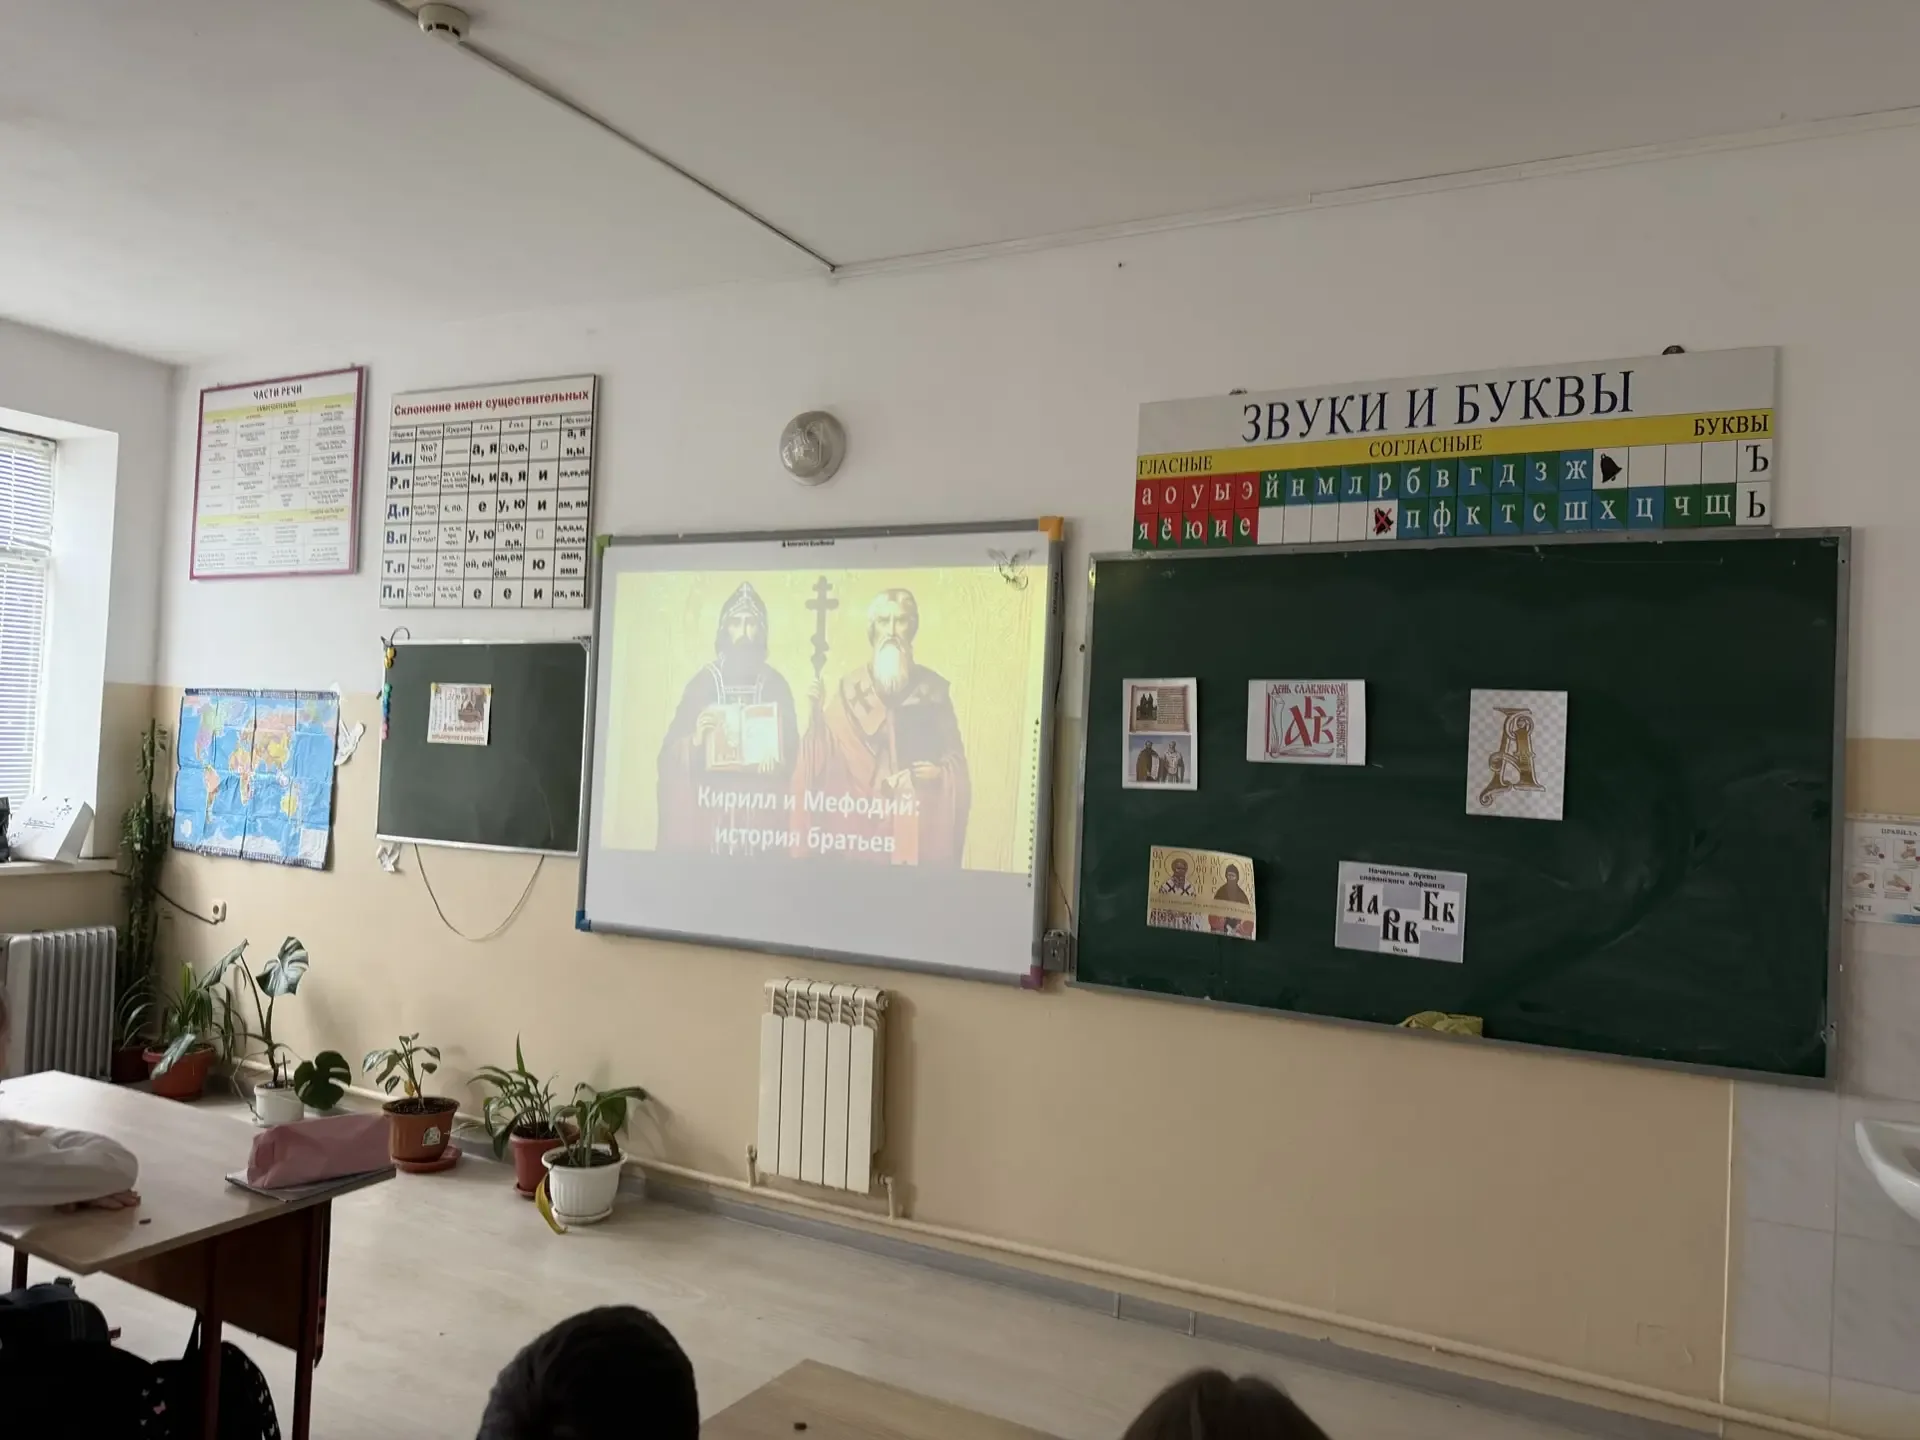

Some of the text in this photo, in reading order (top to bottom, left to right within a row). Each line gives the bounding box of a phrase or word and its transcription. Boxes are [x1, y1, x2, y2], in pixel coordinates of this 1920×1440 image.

[253, 384, 302, 400] ЧАСТИ РЕЧИ
[394, 390, 589, 416] Склонение имен существительных
[1242, 370, 1634, 443] ЗВУКИ И БУКВЫ
[1138, 414, 1769, 475] ГЛАСНЫЕ СОГЛАСНЫЕ БУКВЫ
[1142, 445, 1769, 509] а о у ы э й н м л р б в г д з ж Ъ
[1138, 490, 1766, 541] я ё ю и е п ф к т с ш х ц ч щ Ь
[697, 784, 921, 818] Кирилл и Мефодий:
[715, 826, 896, 853] история братьев
[1368, 867, 1409, 877] Начальные
